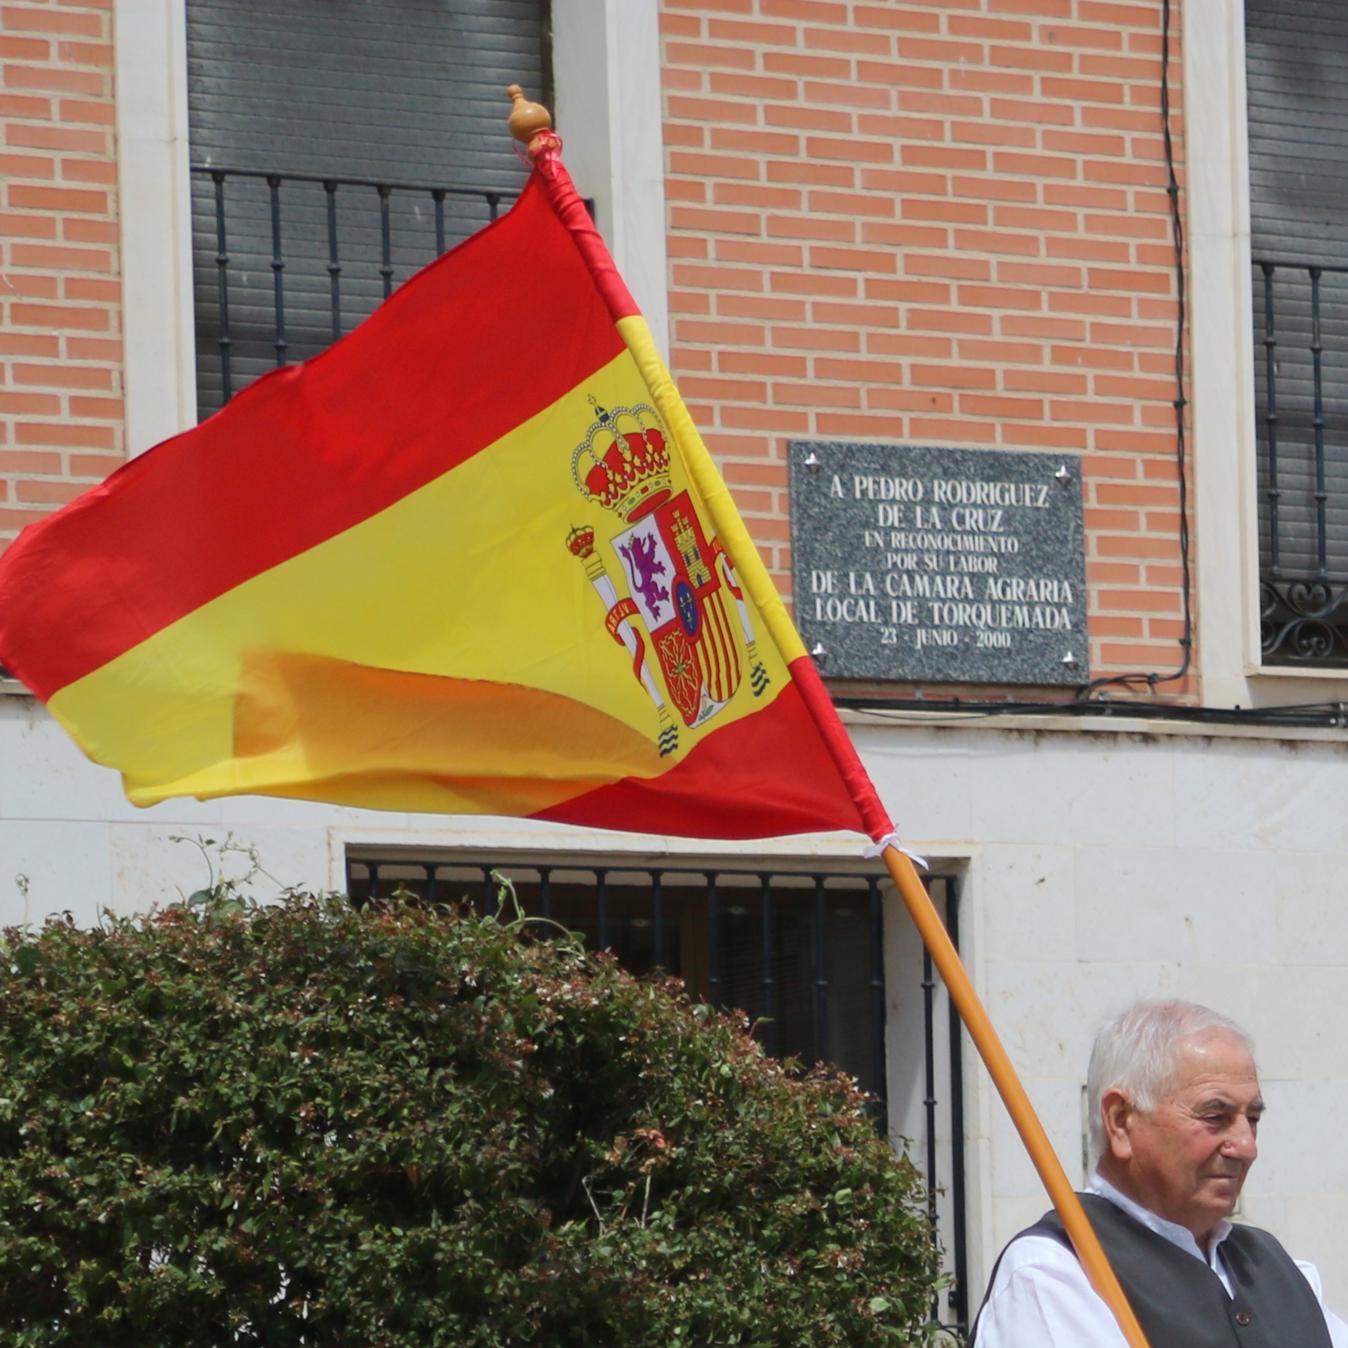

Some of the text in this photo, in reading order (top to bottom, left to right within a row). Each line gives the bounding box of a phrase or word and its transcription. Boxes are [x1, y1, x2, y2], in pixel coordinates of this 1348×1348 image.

[831, 475, 1049, 508] A PEDRO RODRIGUEZ
[878, 505, 1004, 532] DE LA CRUZ
[865, 531, 1019, 554] EN RECONOCIMIENTO
[887, 553, 998, 573] POR SU LABOR
[811, 571, 1073, 603] DE LA CAMARA AGRARIA
[815, 599, 1072, 630] LOCAL DE TORQUEMADA
[881, 628, 897, 645] 23
[916, 629, 958, 649] JUNIO
[976, 631, 1011, 648] 2000
